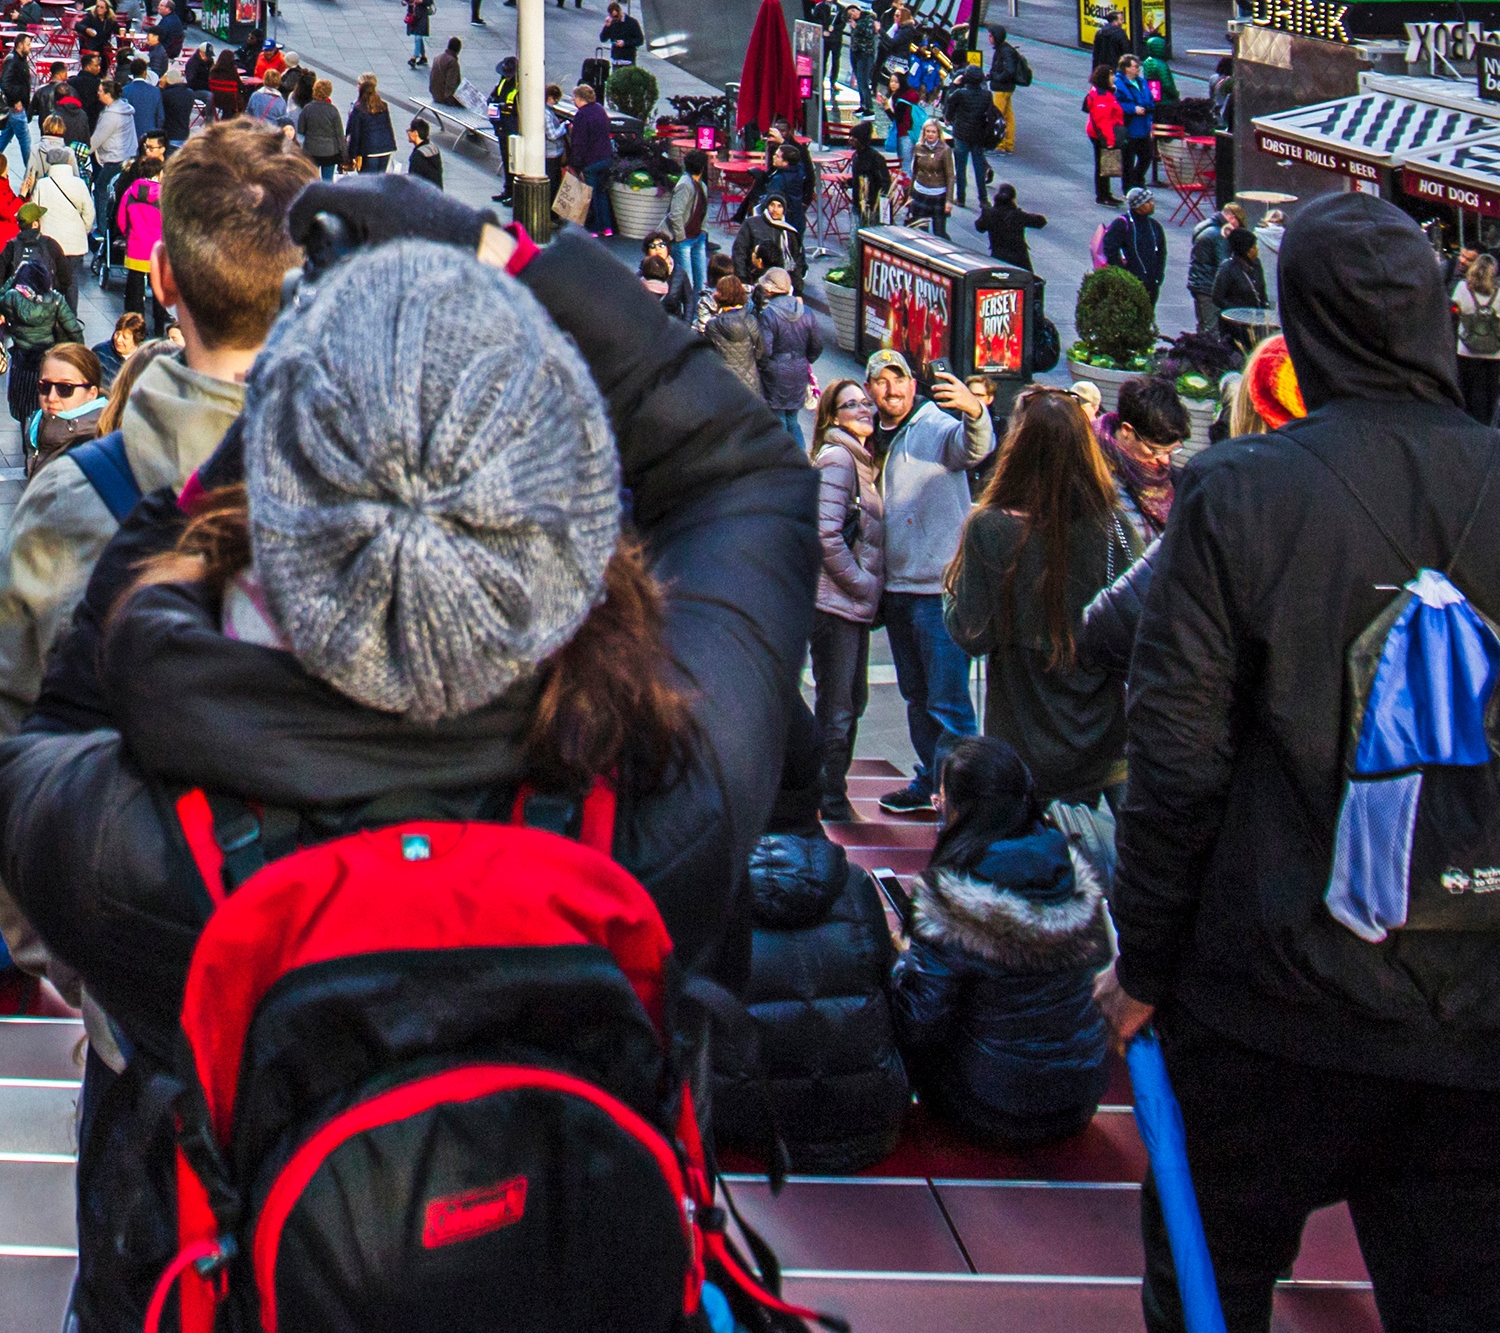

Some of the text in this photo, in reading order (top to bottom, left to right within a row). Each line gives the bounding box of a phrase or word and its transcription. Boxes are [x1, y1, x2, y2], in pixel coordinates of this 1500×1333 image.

[1262, 136, 1377, 179] LOBSTER ROLLS BEER
